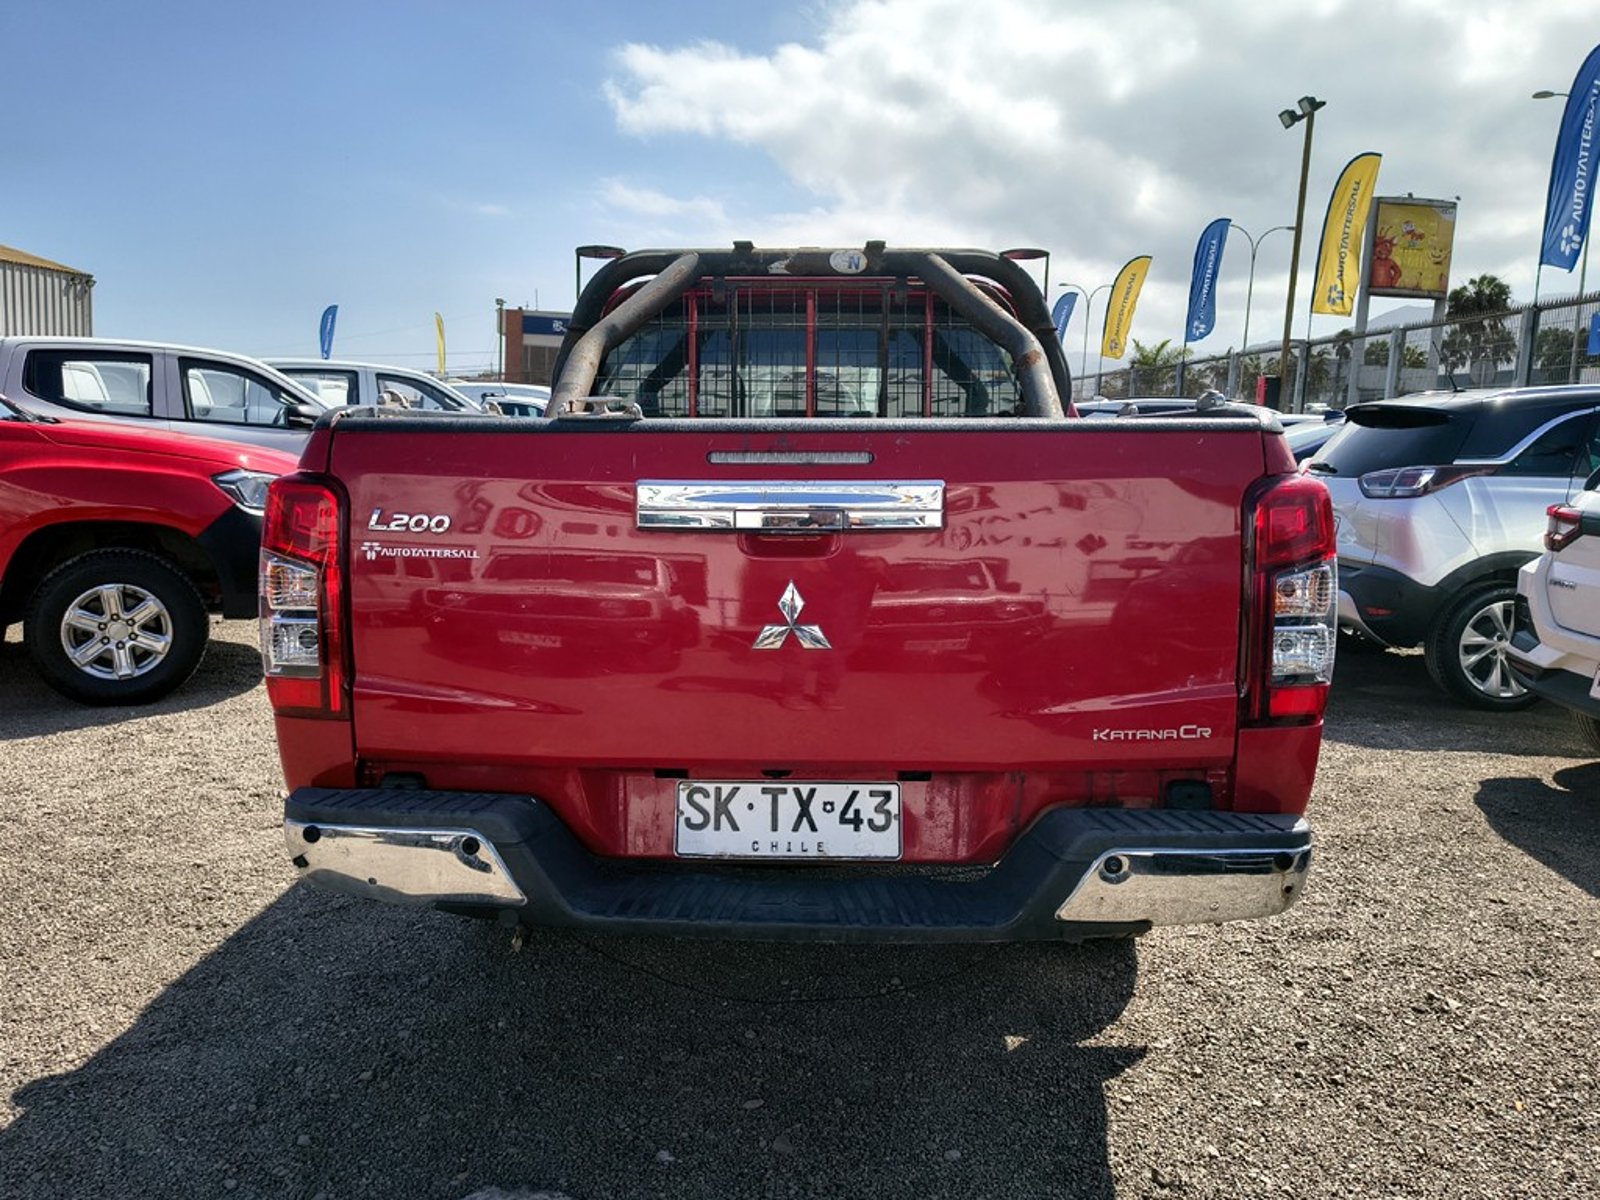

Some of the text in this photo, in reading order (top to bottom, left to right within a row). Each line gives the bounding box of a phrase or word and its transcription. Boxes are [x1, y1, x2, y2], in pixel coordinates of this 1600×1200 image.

[1336, 178, 1361, 280] AUTOTATTERSALL
[368, 508, 451, 532] L200
[380, 547, 480, 559] AUTOTATTERSALL
[752, 840, 824, 853] CHILE
